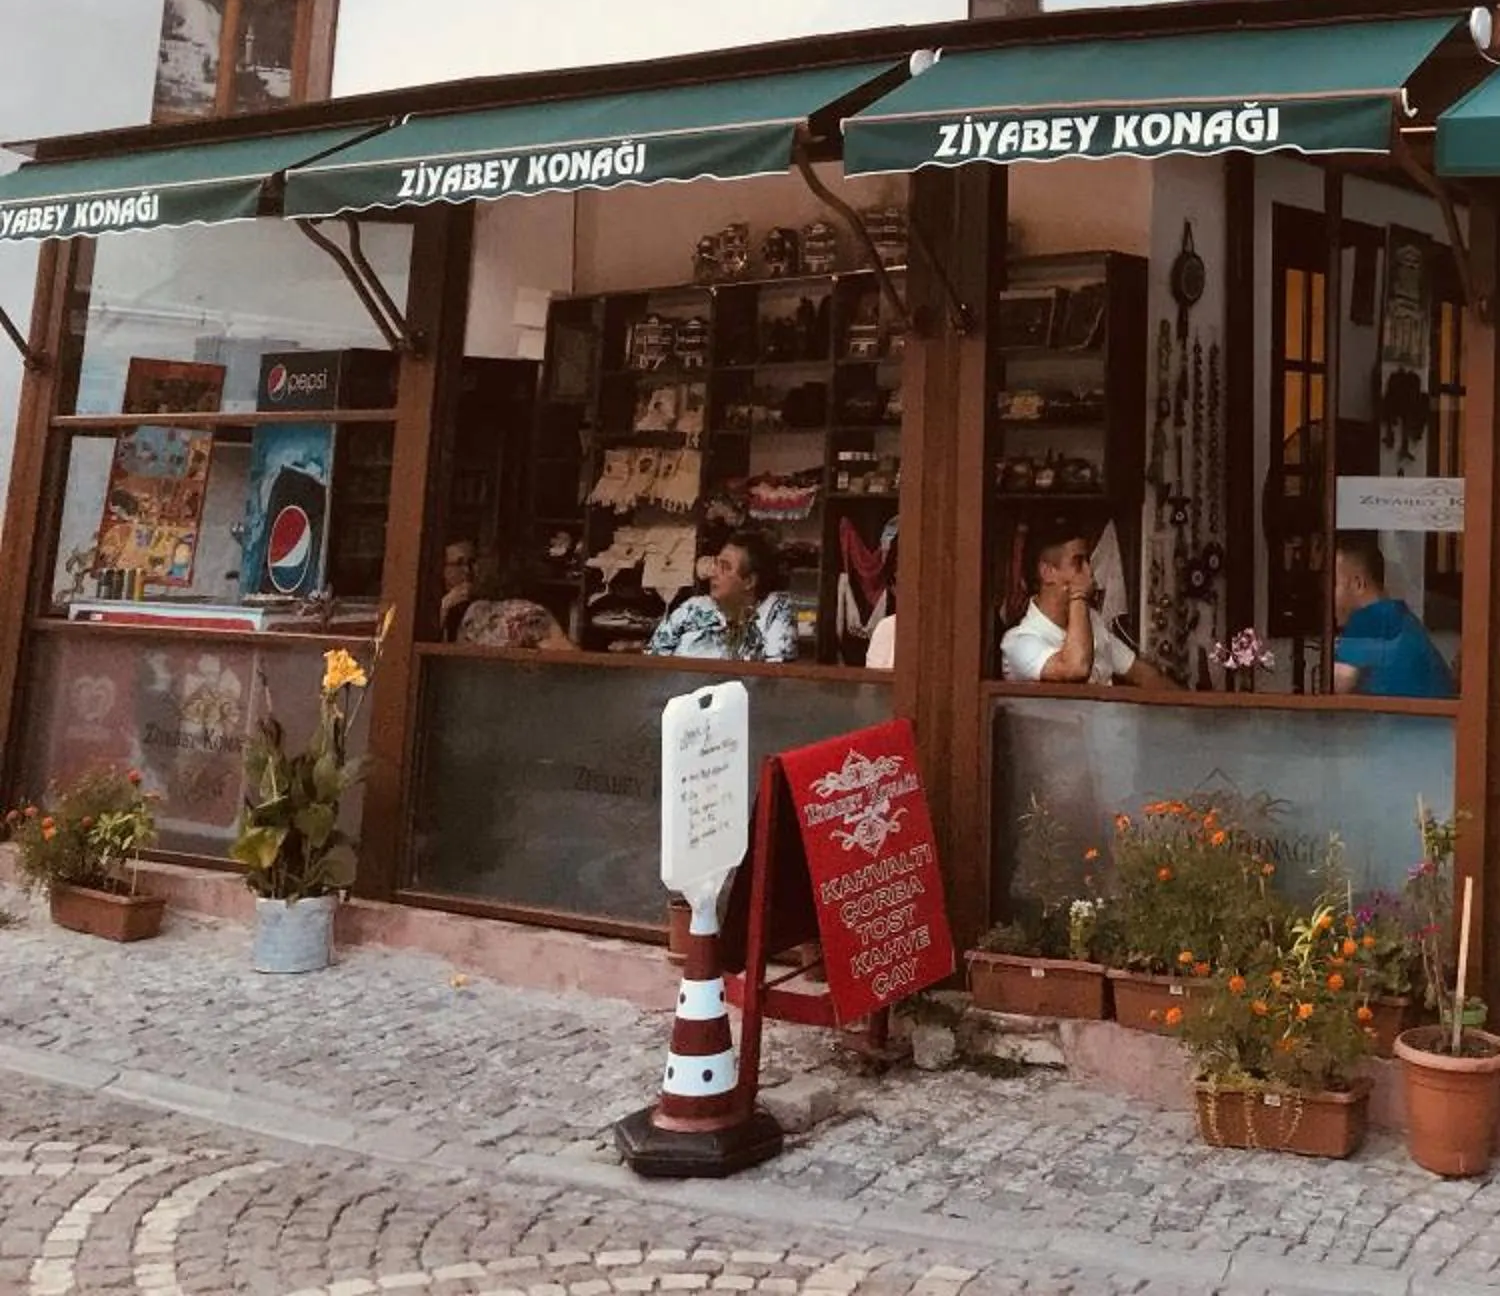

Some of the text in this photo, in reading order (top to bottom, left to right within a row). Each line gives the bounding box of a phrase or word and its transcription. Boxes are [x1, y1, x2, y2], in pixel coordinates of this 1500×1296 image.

[934, 101, 1280, 158] ZİYABEY KONAĞI
[397, 140, 647, 198] ZİYABEY KONAĞI
[0, 191, 160, 236] YABEY KONAĞI
[287, 367, 328, 396] pepsi
[820, 842, 934, 905] KAHVALTI
[839, 874, 926, 929] ÇORBA
[850, 923, 932, 980] KAHVE
[856, 903, 917, 946] TOST
